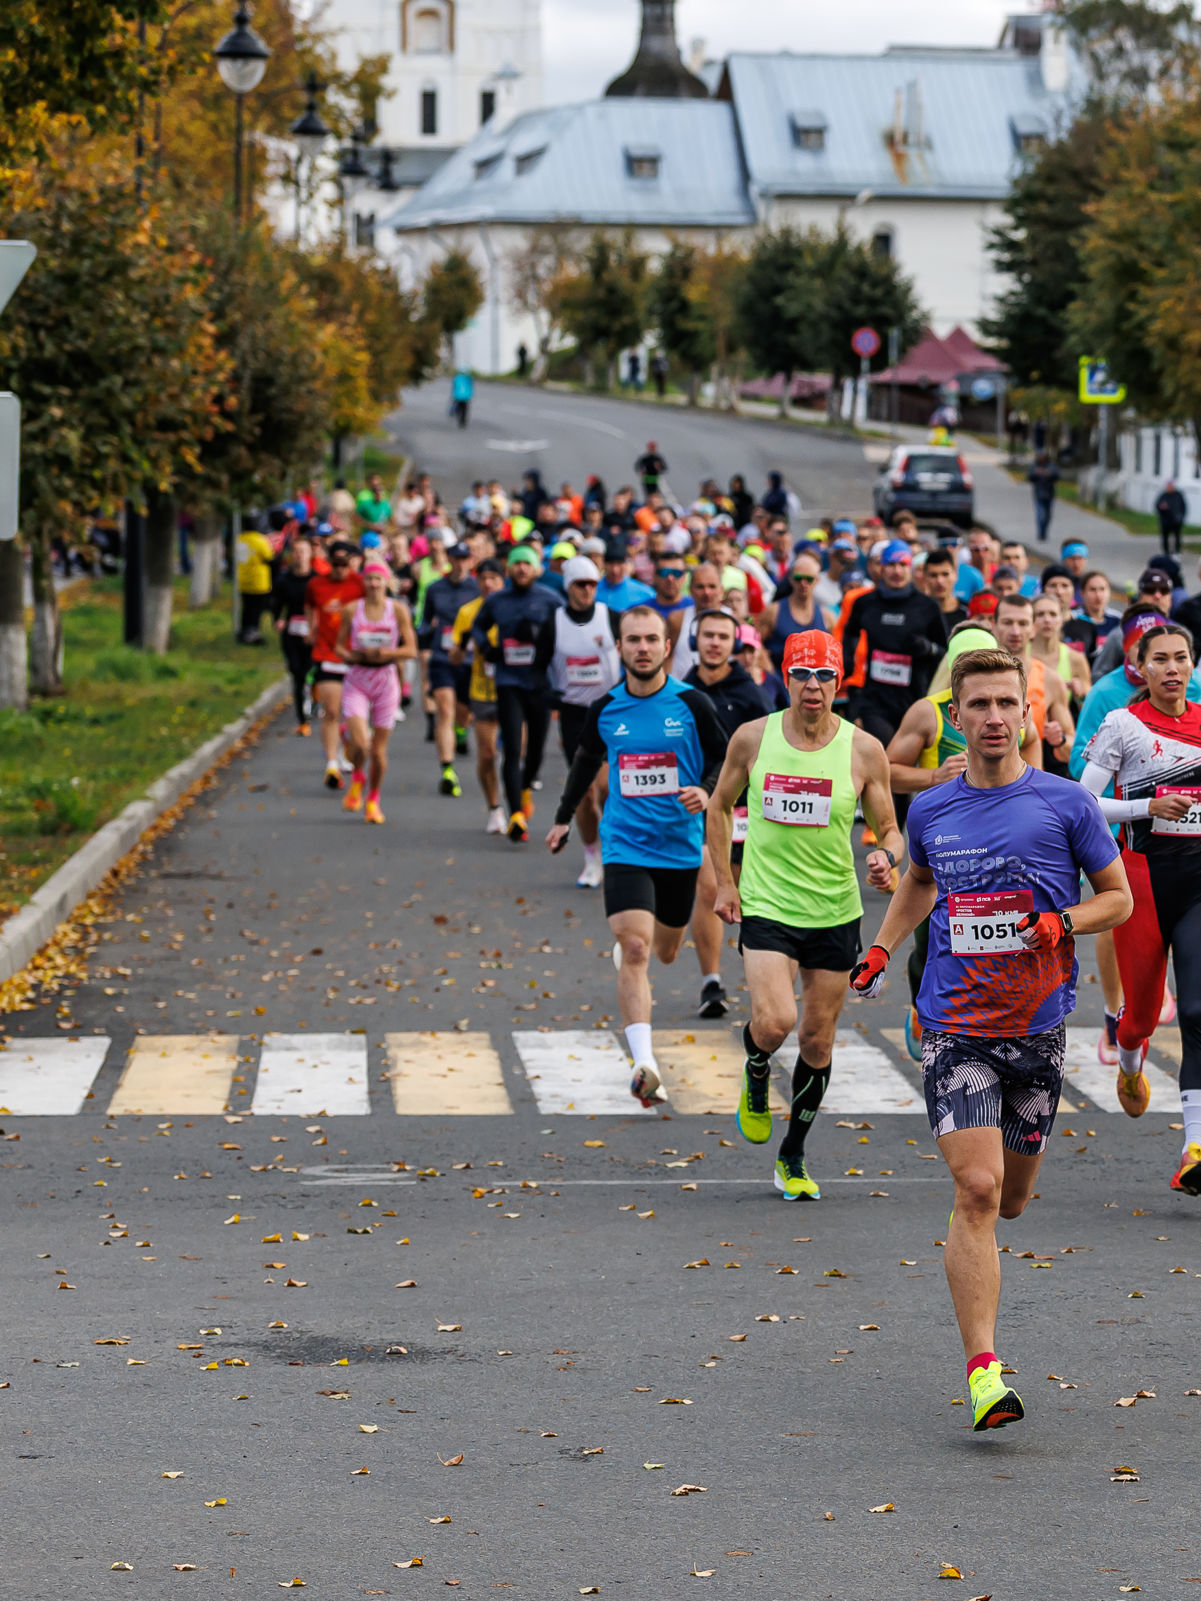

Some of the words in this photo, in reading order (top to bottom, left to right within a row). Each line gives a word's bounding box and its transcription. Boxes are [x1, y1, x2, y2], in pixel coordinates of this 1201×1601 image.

[634, 773, 666, 786] 1393
[781, 800, 813, 814] 1011
[936, 848, 988, 858] ПОЛУМАРАФОН
[971, 922, 1017, 940] 1051
